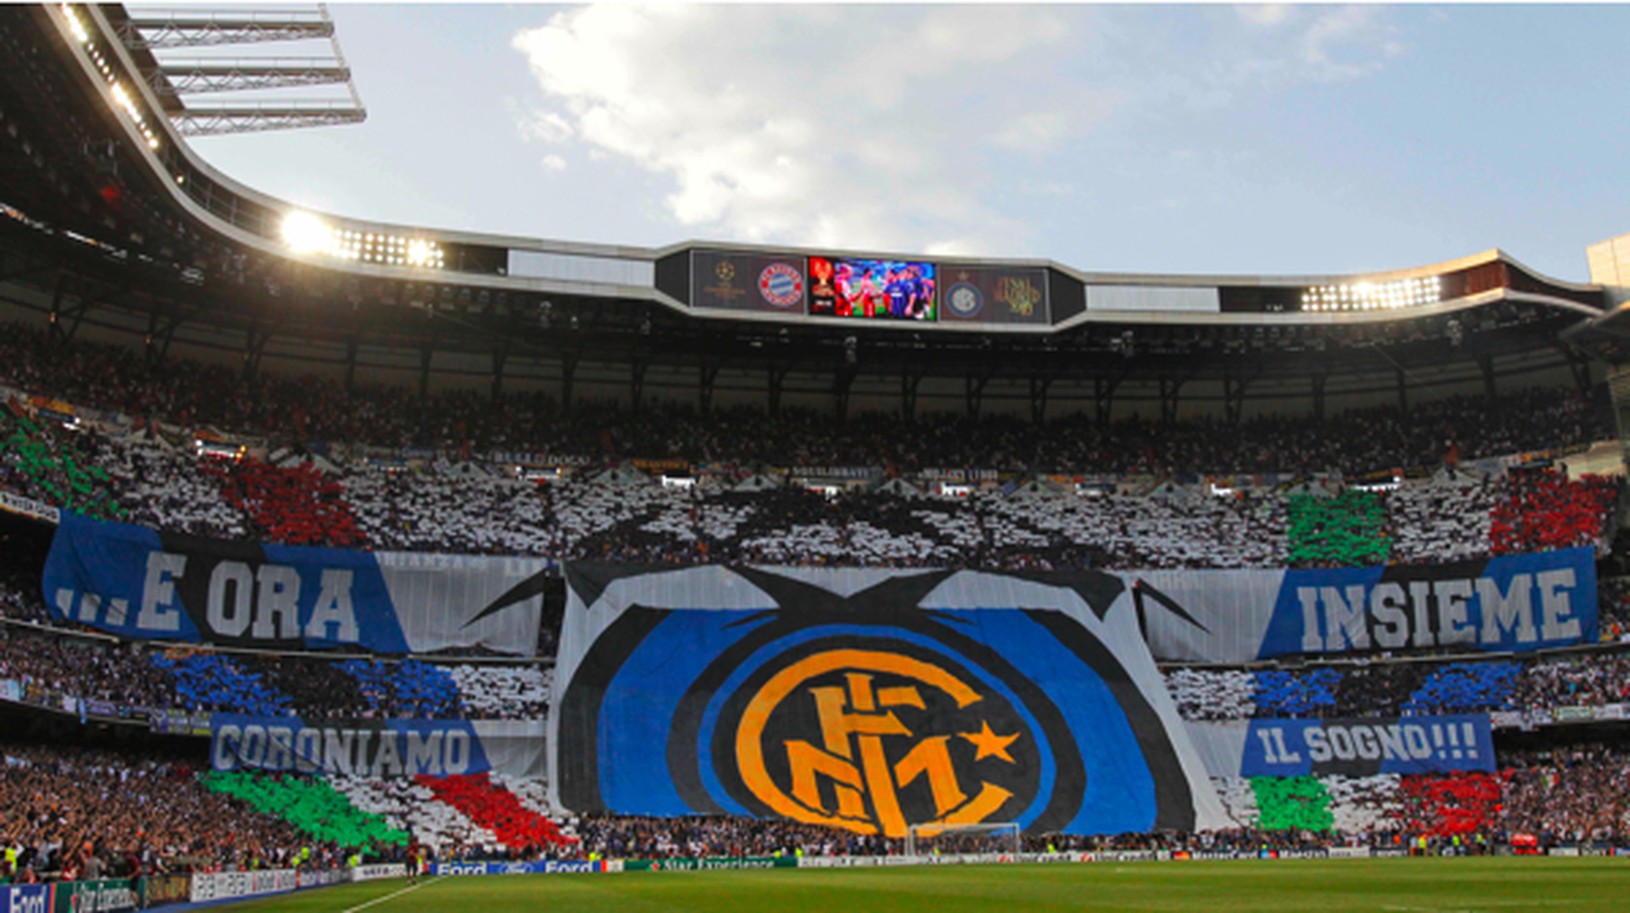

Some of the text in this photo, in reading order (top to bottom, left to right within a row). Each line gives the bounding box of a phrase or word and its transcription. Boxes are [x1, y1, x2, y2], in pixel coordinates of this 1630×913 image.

[207, 560, 359, 643] ORA
[1297, 568, 1582, 651] INSIEME
[214, 725, 470, 776] CORONIAMO
[1257, 722, 1478, 763] IL SOGNO!!!
[437, 863, 488, 876] Ford
[545, 861, 592, 873] Ford
